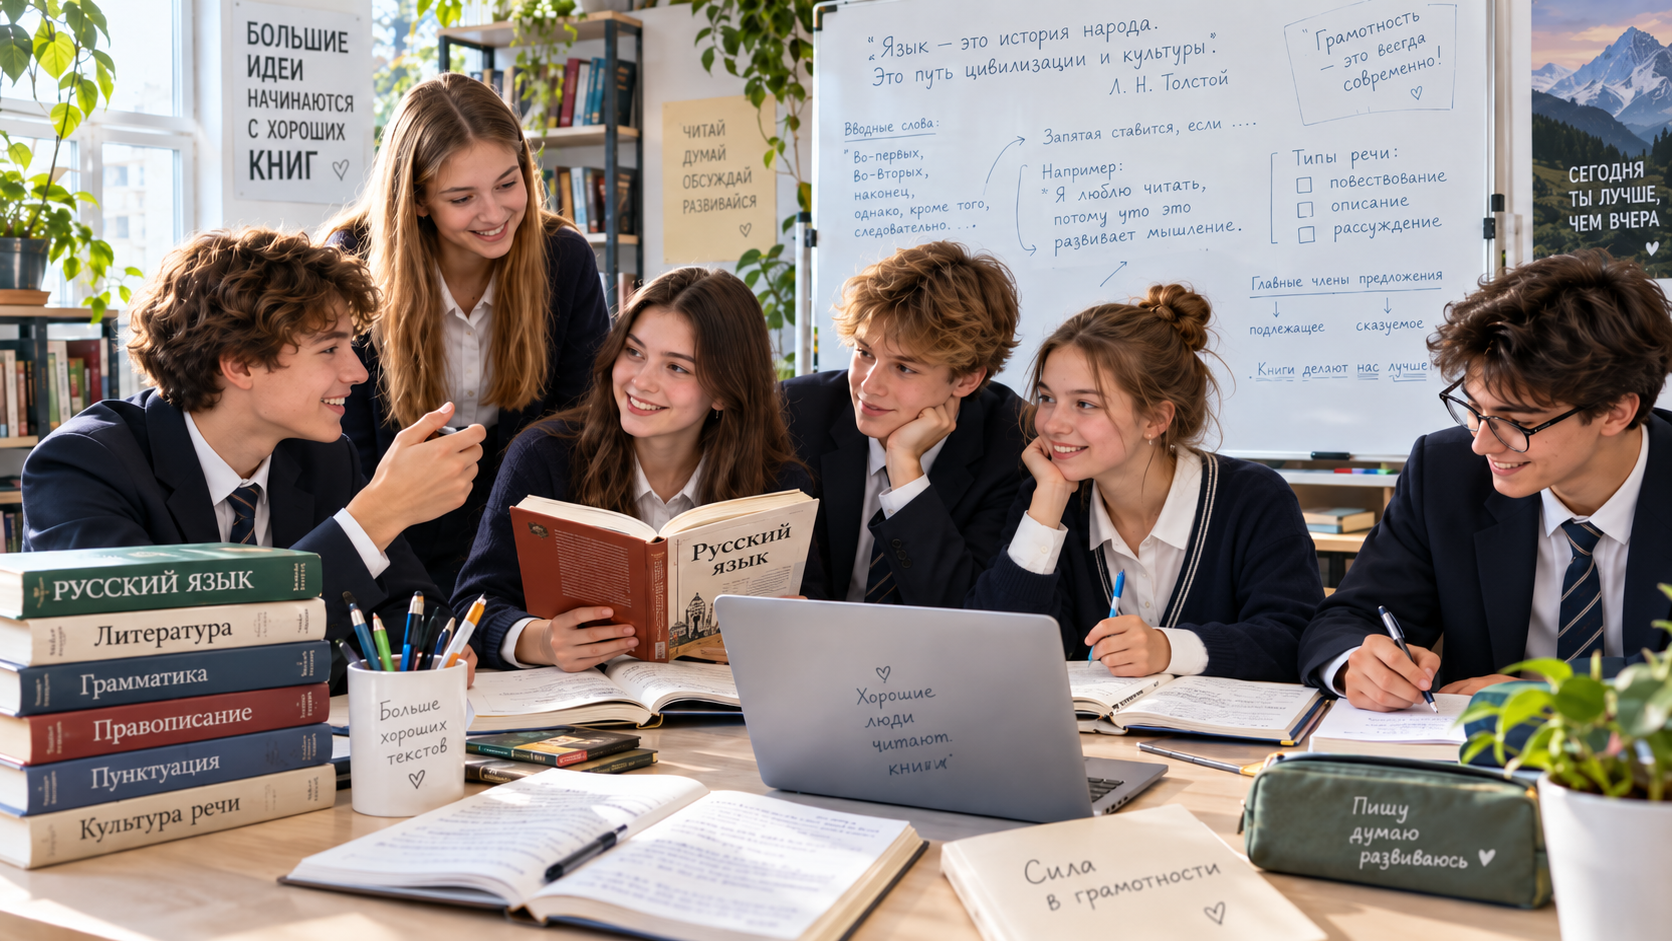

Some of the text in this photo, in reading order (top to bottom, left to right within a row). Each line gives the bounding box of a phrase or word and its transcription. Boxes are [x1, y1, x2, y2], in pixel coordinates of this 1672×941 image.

[247, 21, 349, 54] БОЛЬШИЕ
[961, 35, 988, 51] это
[999, 26, 1070, 50] история
[1083, 19, 1159, 42] народа.
[247, 54, 304, 83] ИДЕИ
[872, 67, 904, 87] Это
[915, 67, 953, 89] путь
[965, 55, 1086, 79] цивилизации
[1100, 50, 1110, 65] и
[1343, 52, 1368, 68] это
[1343, 45, 1442, 91] современно!
[1109, 69, 1229, 95] Л. Н. Толстой
[248, 88, 354, 113] НАЧИНАЮТСЯ
[248, 118, 346, 141] С ХОРОШИХ
[683, 119, 726, 139] ЧИТАЙ
[844, 117, 940, 136] Вводные слова:
[1043, 128, 1102, 145] Запятая
[1111, 122, 1180, 138] ставится,
[1188, 119, 1222, 132] если
[249, 149, 318, 181] КНИГ
[683, 144, 727, 168] ДУМАЙ
[1292, 148, 1398, 170] Типы речи:
[683, 166, 753, 190] ОБСУЖДАЙ
[854, 167, 929, 184] Во-вторых,
[1042, 162, 1123, 183] Например:
[1330, 171, 1448, 189] повествование
[1568, 160, 1644, 184] СЕГОДНЯ
[854, 187, 915, 201] наконец,
[1078, 182, 1132, 202] люблю
[1144, 179, 1206, 195] читать,
[1568, 185, 1661, 207] ТЫ ЛУЧШЕ,
[683, 193, 757, 215] РАЗВИВАЙСЯ
[854, 200, 990, 221] однако, кроме того,
[1054, 211, 1108, 228] потому
[1161, 203, 1192, 216] это
[1331, 196, 1410, 212] описание
[1334, 216, 1443, 243] рассуждение
[1568, 210, 1660, 233] ЧЕМ ВЧЕРА
[1054, 221, 1242, 257] развивает мышление.
[1251, 270, 1443, 291] Главные члены предложения
[1249, 319, 1425, 338] подлежащее сказуемое
[1257, 361, 1428, 379] Книги делают нас лучше
[691, 522, 792, 563] Русский
[711, 551, 769, 577] язык
[53, 570, 255, 601] РУССКИЙ ЯЗЫК
[94, 621, 233, 648] Литература
[80, 668, 209, 700] Грамматика
[380, 699, 441, 722] Больше
[856, 687, 936, 710] Хорошие
[93, 707, 253, 745] Правописание
[864, 713, 915, 729] люди
[380, 720, 447, 747] хороших
[872, 733, 953, 753] читают.
[387, 737, 448, 765] текстов
[91, 755, 220, 792] Пунктуация
[79, 806, 183, 844] Культура
[190, 797, 241, 826] речи
[1352, 796, 1409, 824] Пишу
[1349, 826, 1420, 847] думаю
[1359, 848, 1468, 870] развиваюсь
[1024, 858, 1096, 885] Сила
[1046, 863, 1221, 911] в грамотности
